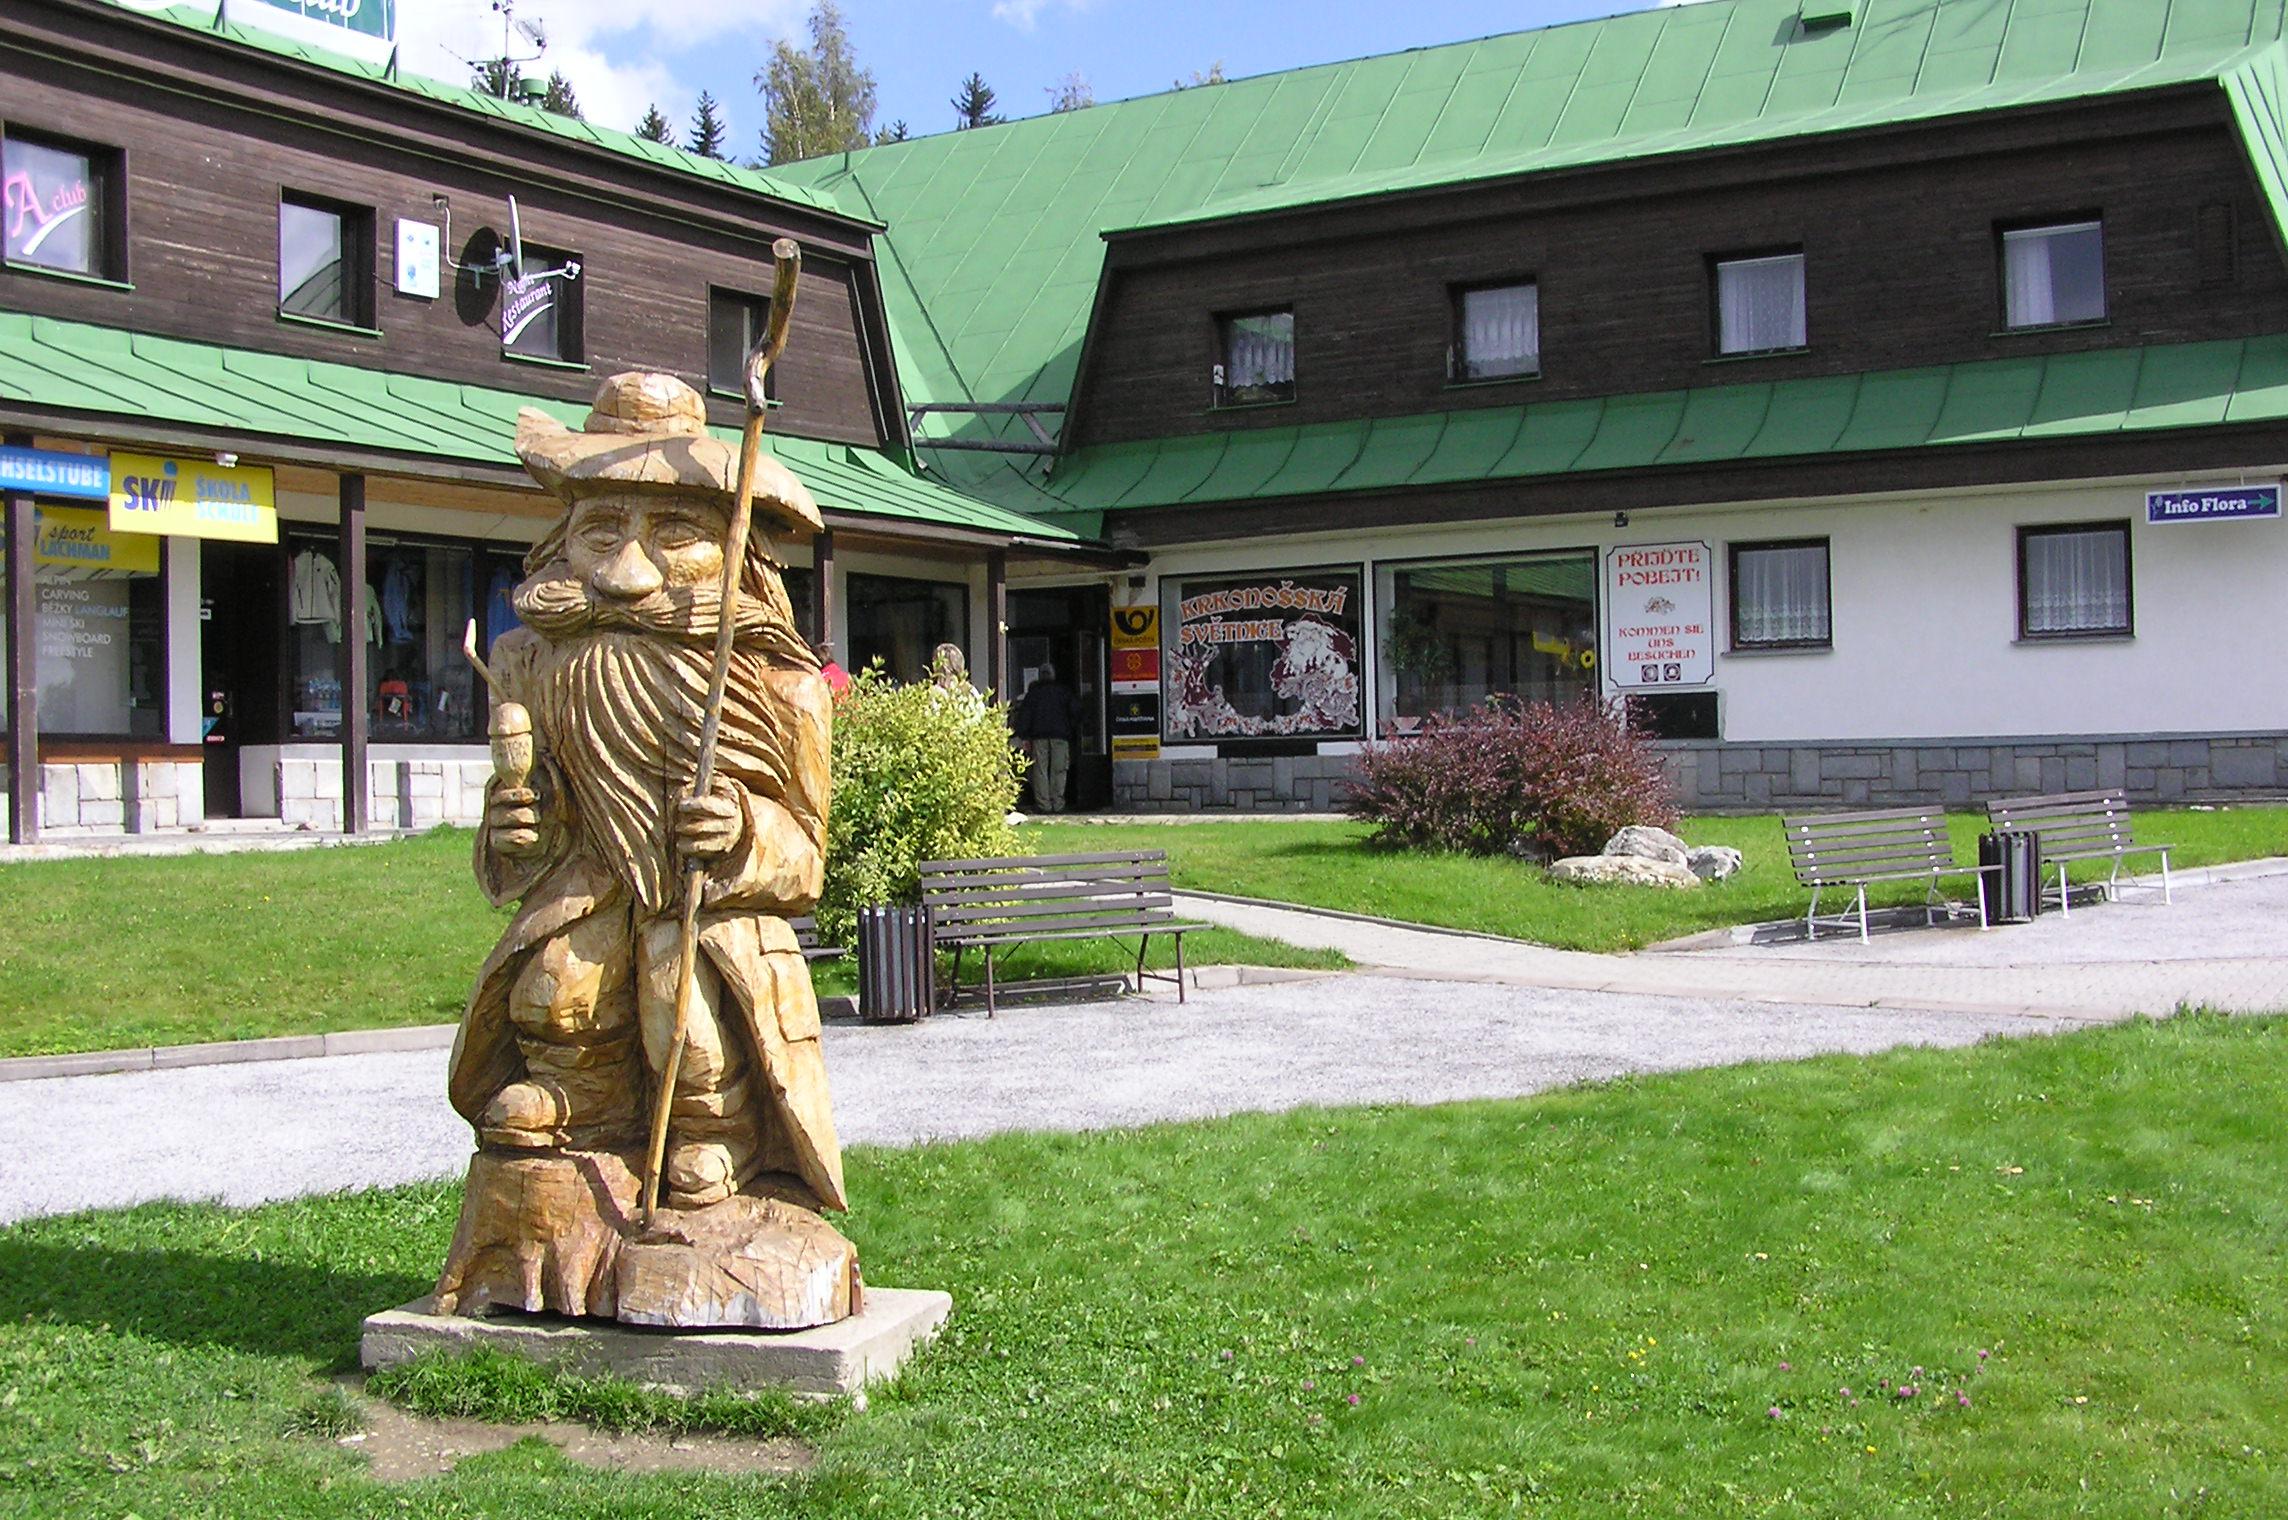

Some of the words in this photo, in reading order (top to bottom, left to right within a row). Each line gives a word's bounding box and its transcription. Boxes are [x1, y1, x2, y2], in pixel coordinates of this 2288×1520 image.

[4, 171, 53, 238] A
[53, 179, 87, 211] club
[502, 282, 553, 333] Restaurant
[123, 461, 178, 514] SKI
[2164, 499, 2200, 515] Info
[2201, 497, 2248, 512] Flora
[49, 525, 97, 542] sport
[40, 540, 111, 561] LACHMAN
[1618, 569, 1701, 587] POBEJT!
[41, 589, 89, 602] CARVING
[1179, 580, 1349, 623] KRKONOŠSKÁ
[42, 631, 112, 645] SNOWBOARD
[1179, 615, 1284, 645] SVĚTNICE
[1618, 626, 1680, 638] KOMMEN
[1684, 624, 1704, 635] SIE
[1648, 638, 1674, 648] UNS
[42, 647, 94, 659] FREESTYLE
[1627, 649, 1696, 662] BESUCHEN
